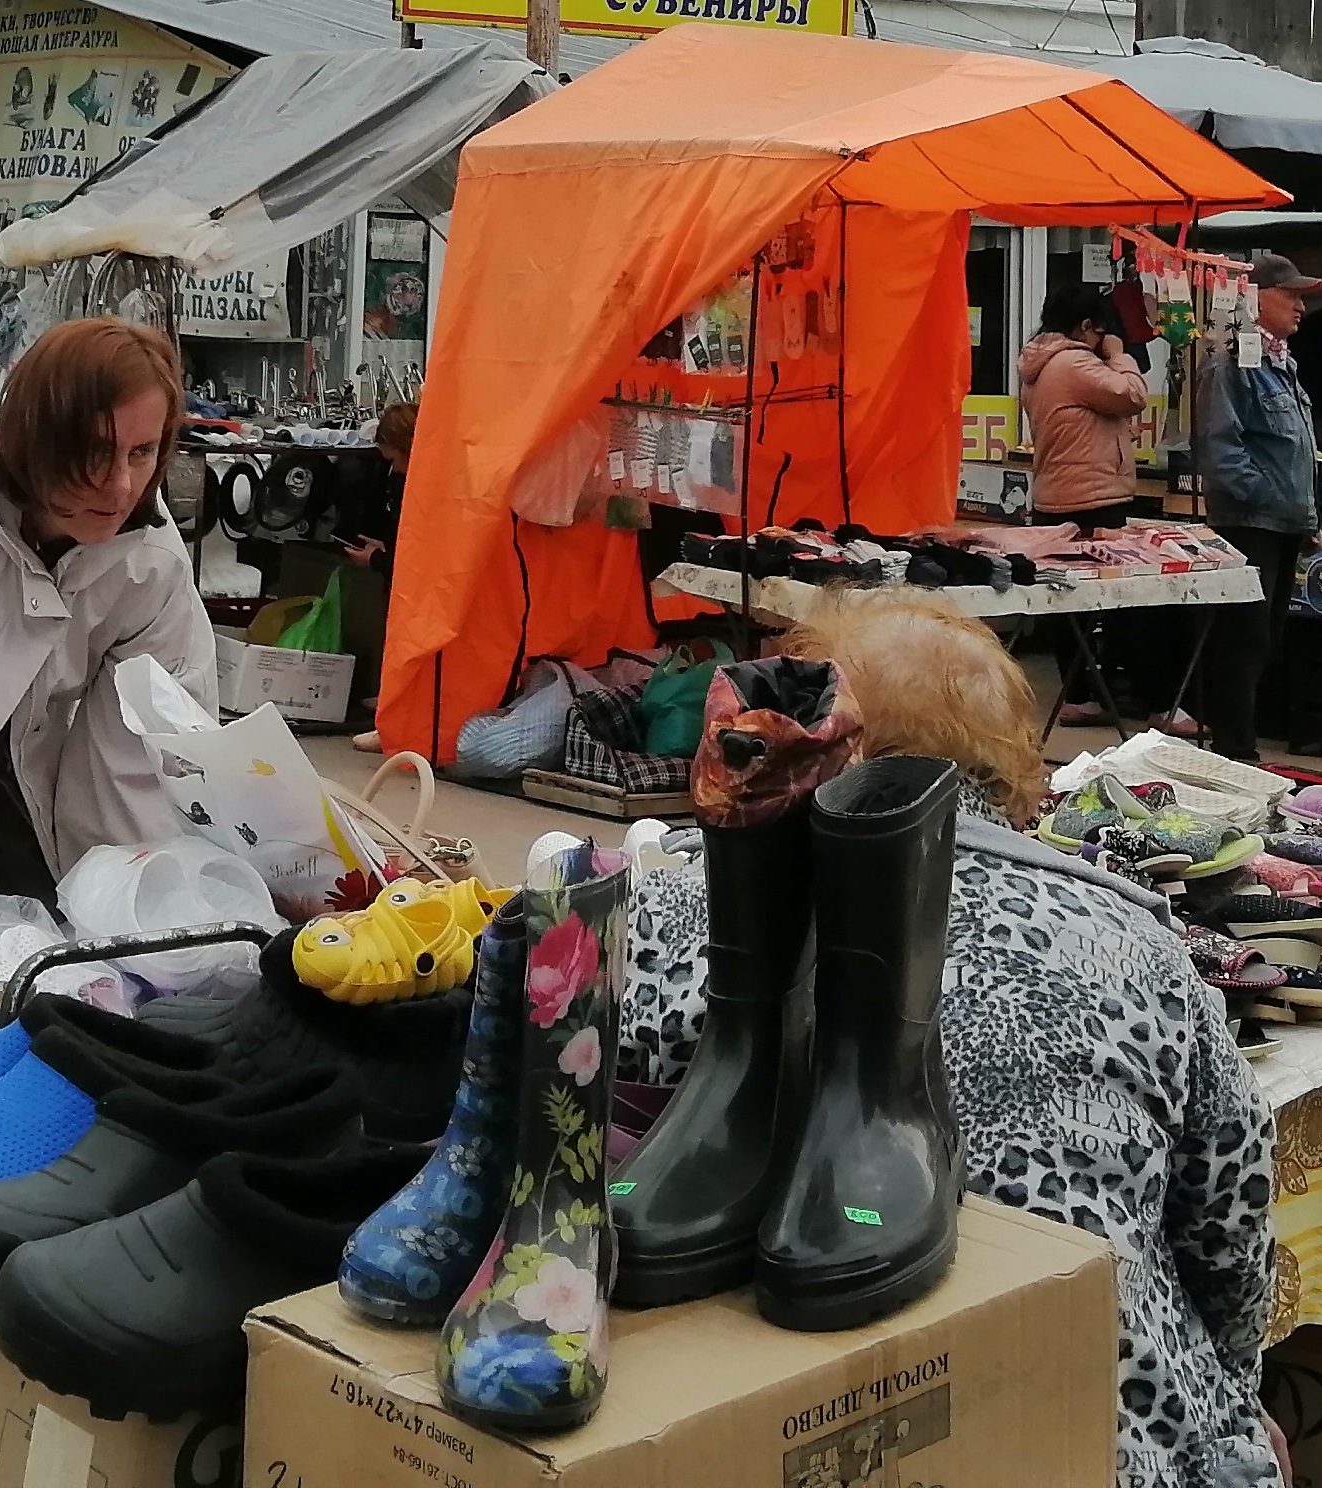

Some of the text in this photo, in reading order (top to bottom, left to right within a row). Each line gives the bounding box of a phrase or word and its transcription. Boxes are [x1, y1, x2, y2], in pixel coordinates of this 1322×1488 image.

[41, 29, 119, 52] ЛИТЕРАТУРА
[20, 127, 86, 152] БУМАГА
[1058, 1124, 1121, 1160] MON
[783, 1352, 950, 1440] КОРОЛЬ ДЕРЕВО
[426, 1422, 474, 1465] Размер
